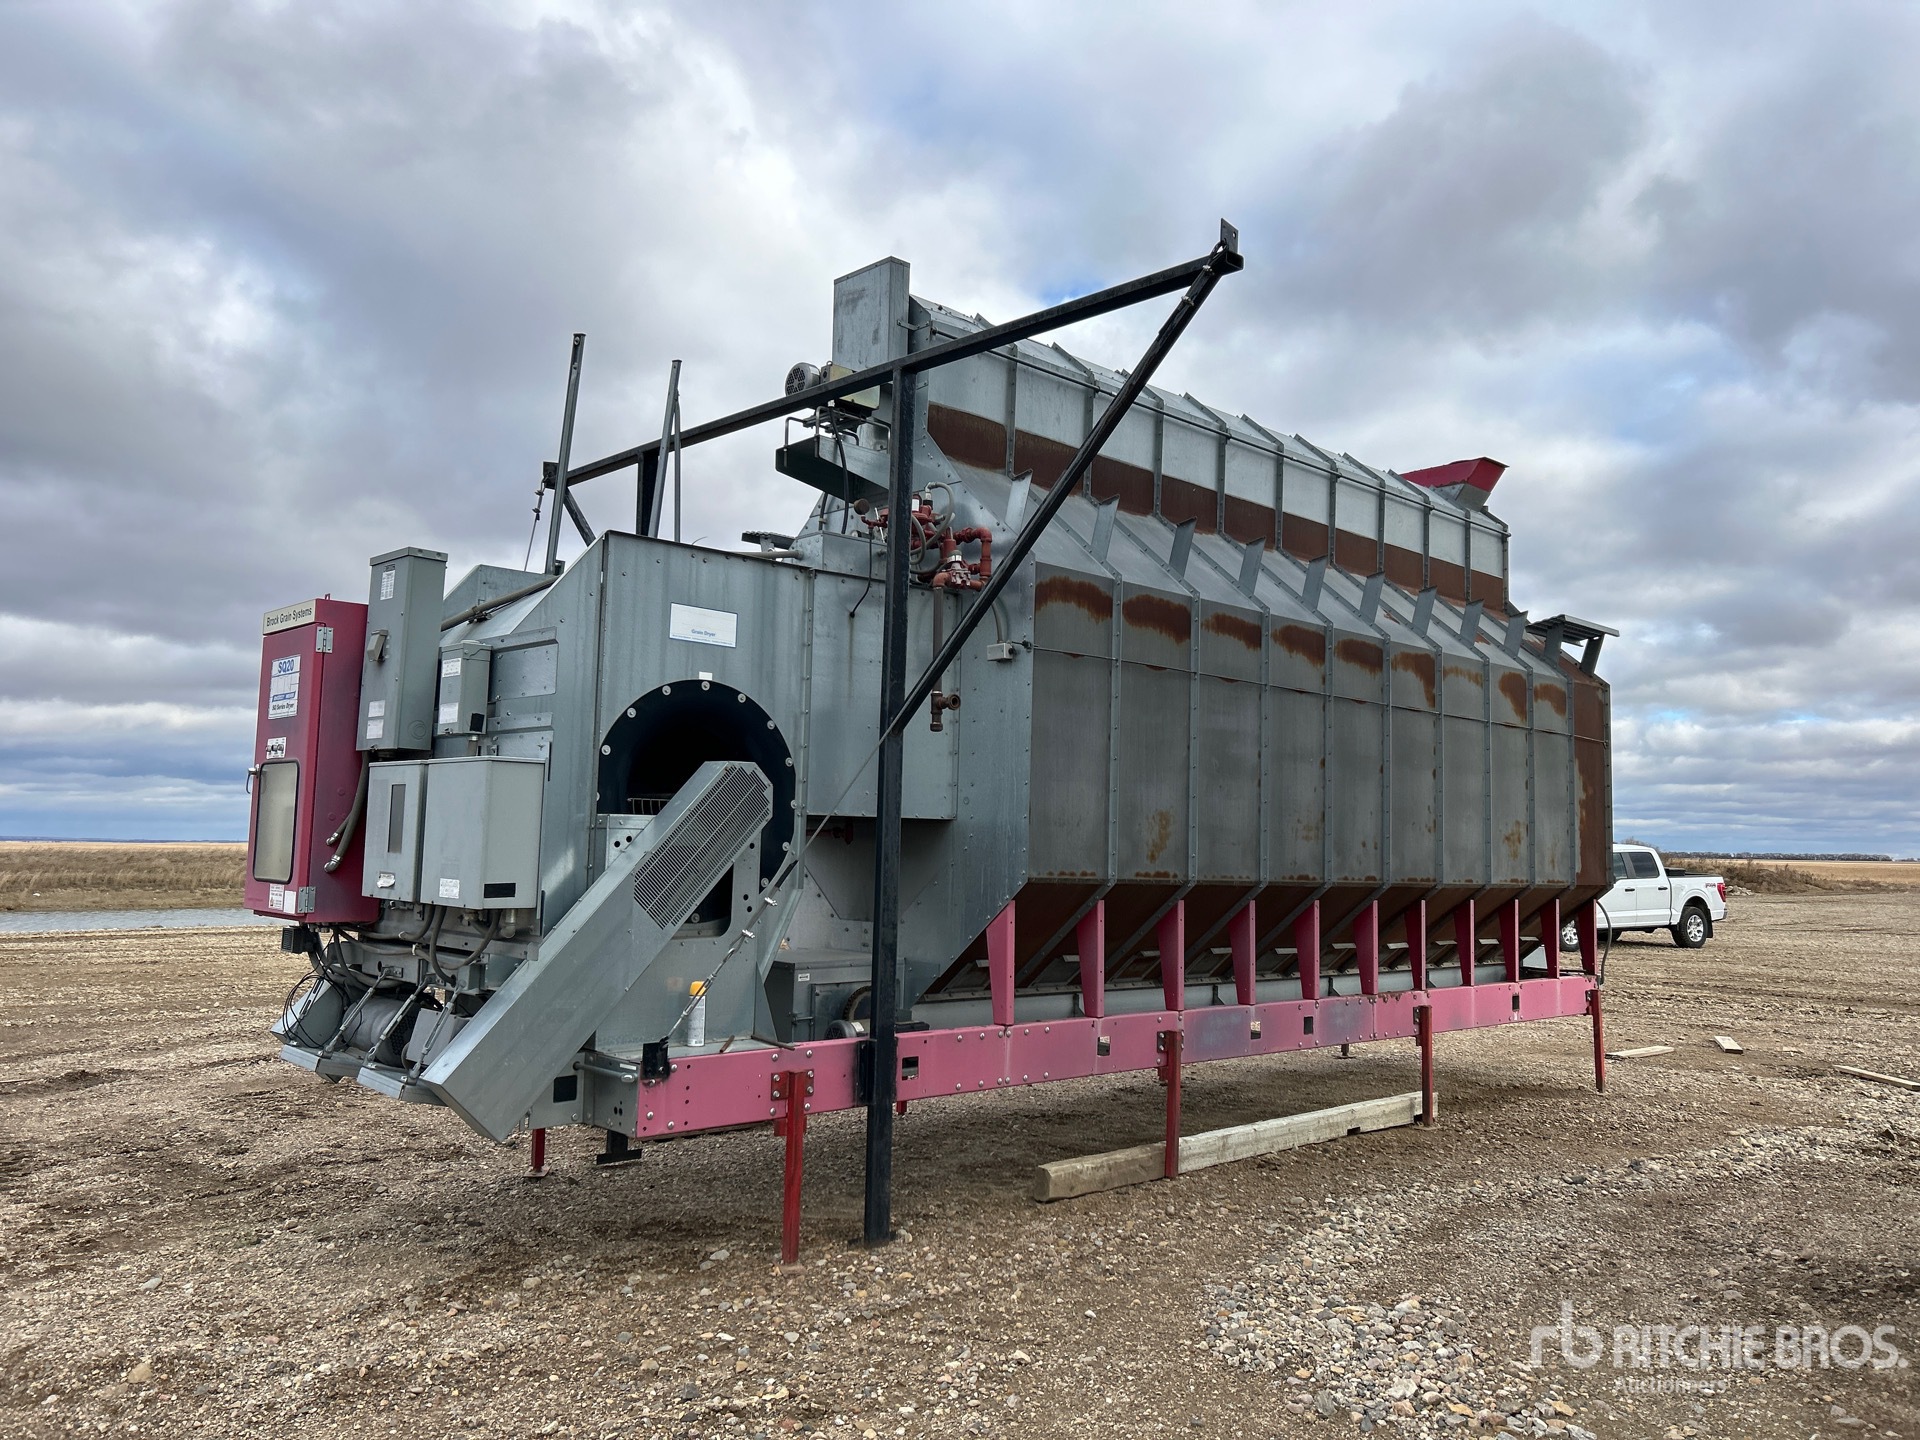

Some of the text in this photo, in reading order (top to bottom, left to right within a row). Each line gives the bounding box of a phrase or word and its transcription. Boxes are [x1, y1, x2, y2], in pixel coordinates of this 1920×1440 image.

[266, 607, 312, 626] Brock Grain Systems
[278, 659, 295, 674] SQ20
